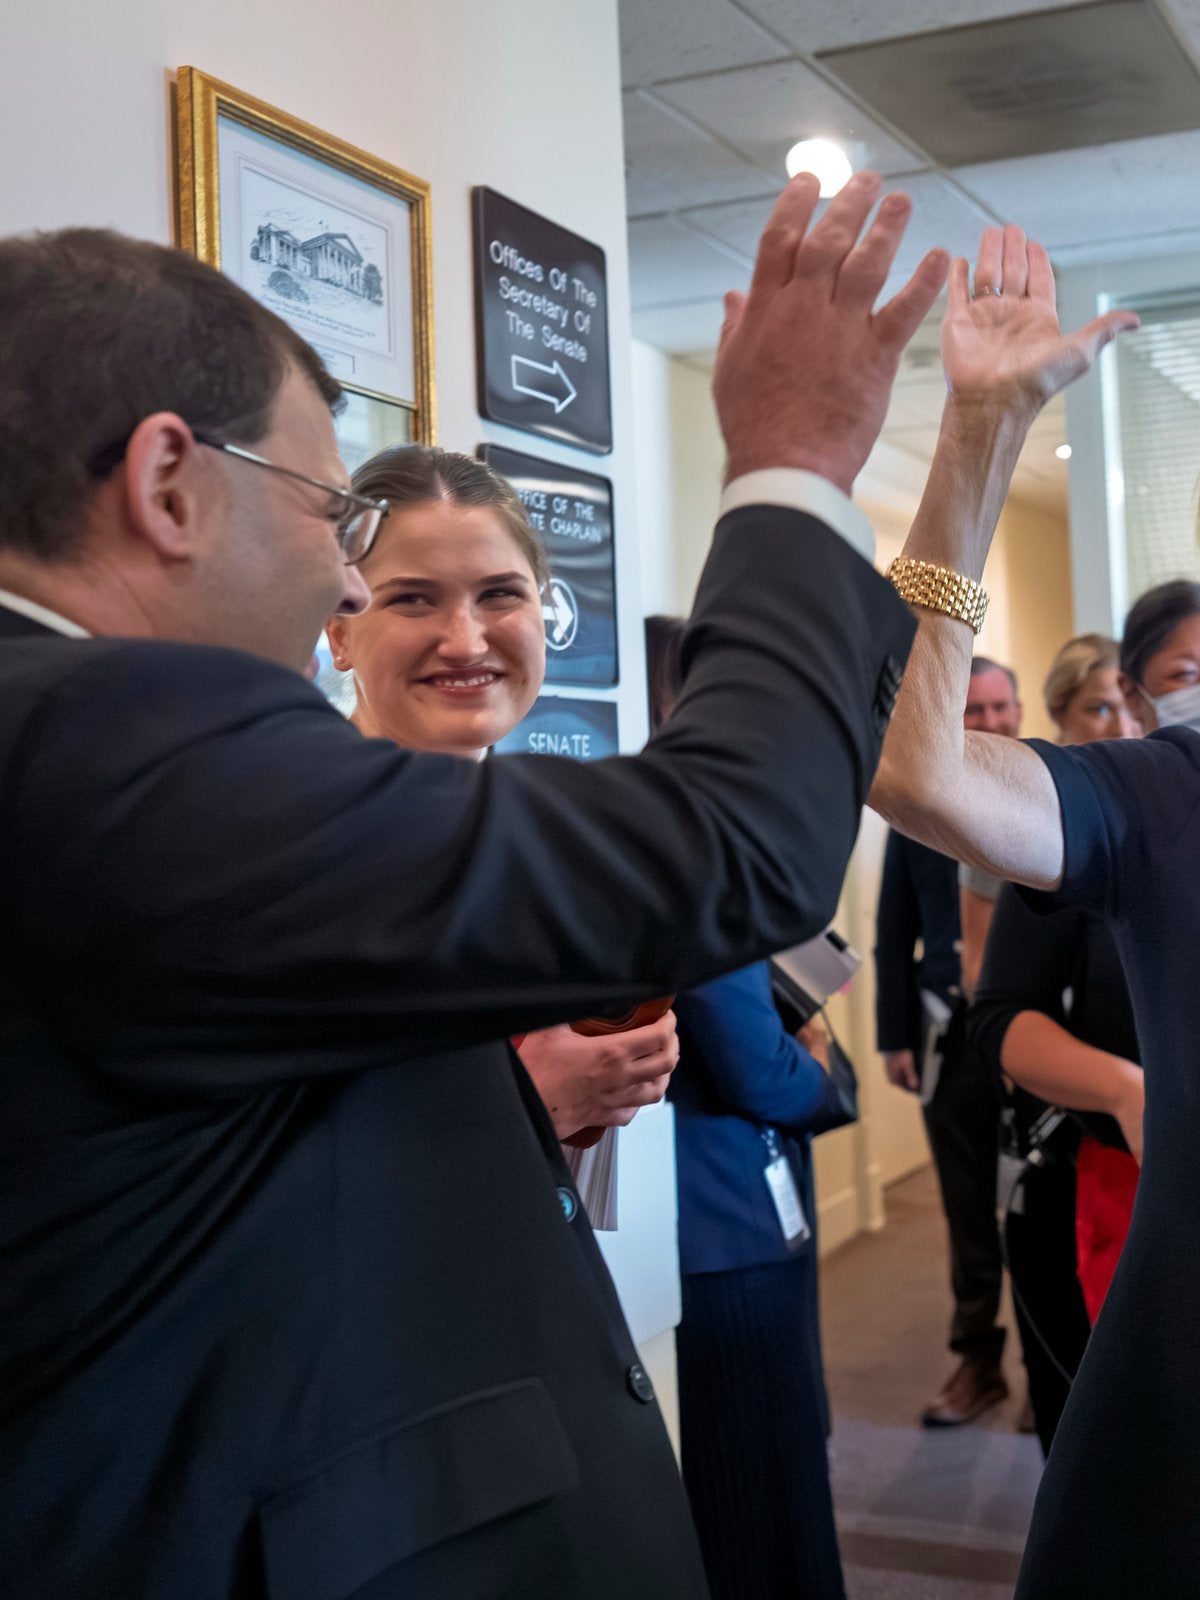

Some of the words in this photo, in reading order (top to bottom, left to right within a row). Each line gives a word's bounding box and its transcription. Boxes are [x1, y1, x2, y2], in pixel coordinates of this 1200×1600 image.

[490, 240, 544, 282] Offices
[549, 267, 567, 293] Of
[572, 278, 597, 308] The
[499, 276, 568, 328] Secretary
[574, 310, 591, 335] Of
[505, 310, 534, 340] The
[541, 325, 587, 362] Senate
[552, 496, 568, 514] OF
[574, 501, 595, 521] THE
[550, 517, 602, 543] CHAPLAIN
[528, 732, 591, 757] SENATE
